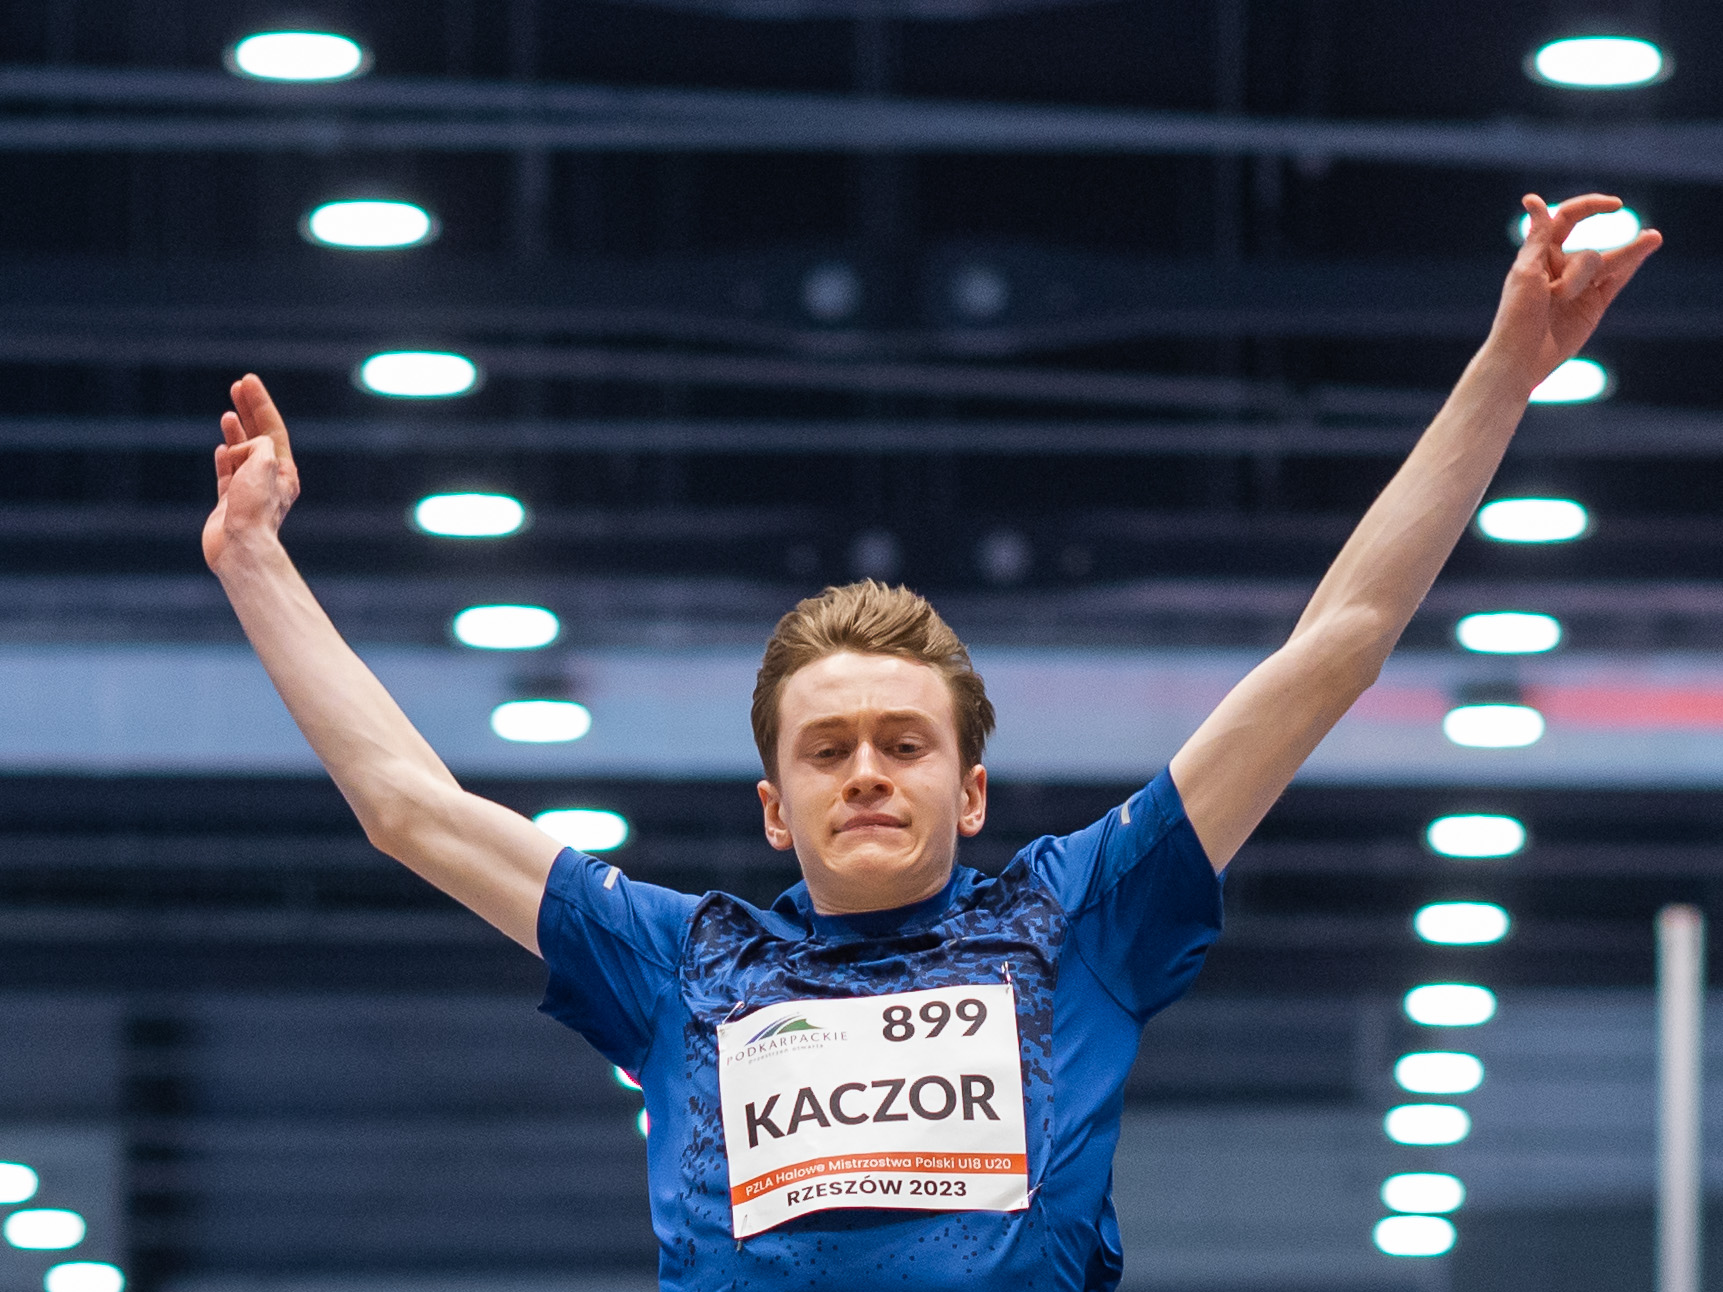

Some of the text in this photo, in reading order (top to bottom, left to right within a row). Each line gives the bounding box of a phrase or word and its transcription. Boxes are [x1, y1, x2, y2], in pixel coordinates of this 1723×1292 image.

[882, 998, 988, 1042] 899
[726, 1031, 848, 1066] PODKARPACKIE
[745, 1074, 1000, 1149] KACZOR
[745, 1156, 1012, 1197] PZLA Halowe Mistrzostwa Polski U18 U20
[787, 1175, 967, 1207] RZESZÓW 2023
